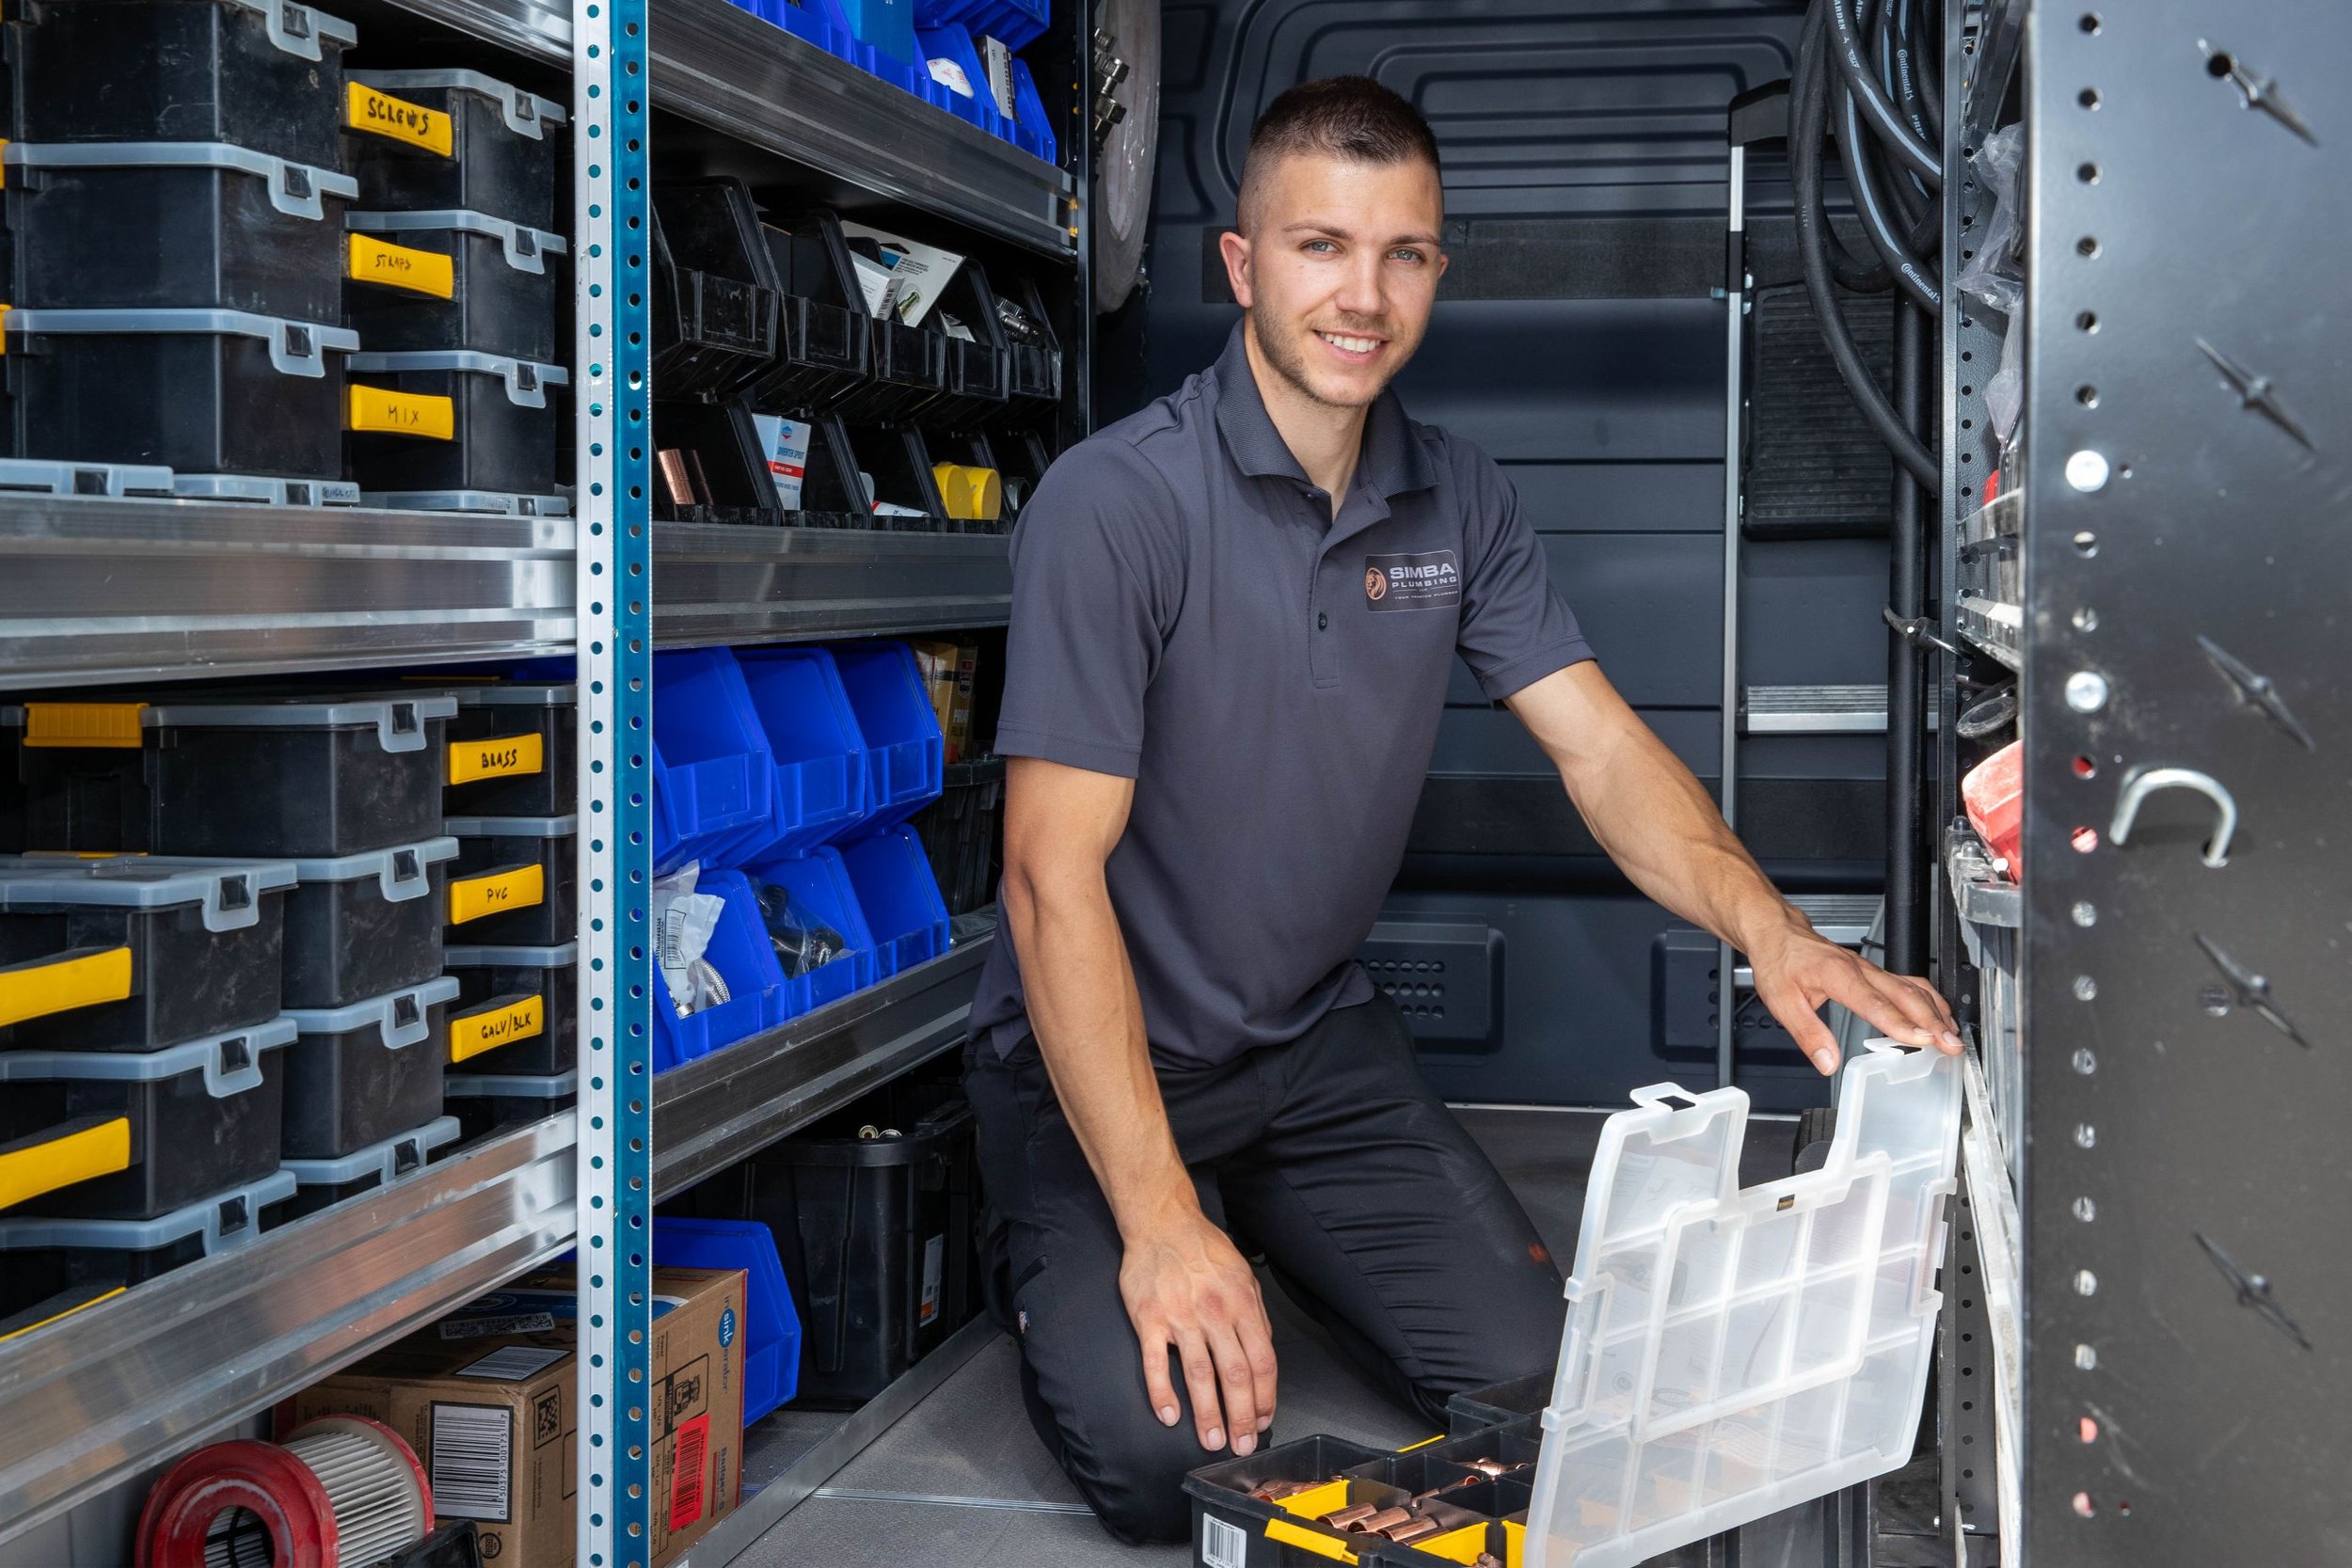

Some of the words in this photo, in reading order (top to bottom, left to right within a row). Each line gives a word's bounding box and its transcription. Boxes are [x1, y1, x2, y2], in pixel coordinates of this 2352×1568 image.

[368, 96, 429, 135] SCREWS
[375, 254, 412, 270] STRAPS
[1900, 262, 1936, 300] Continental
[388, 404, 419, 426] MIX
[1390, 562, 1455, 579] SIMBA
[1391, 576, 1457, 589] PLUMBING
[482, 748, 517, 768] BRASS
[486, 887, 508, 903] PVC
[481, 1012, 532, 1039] GALV/BLK
[499, 1469, 507, 1497] 50375
